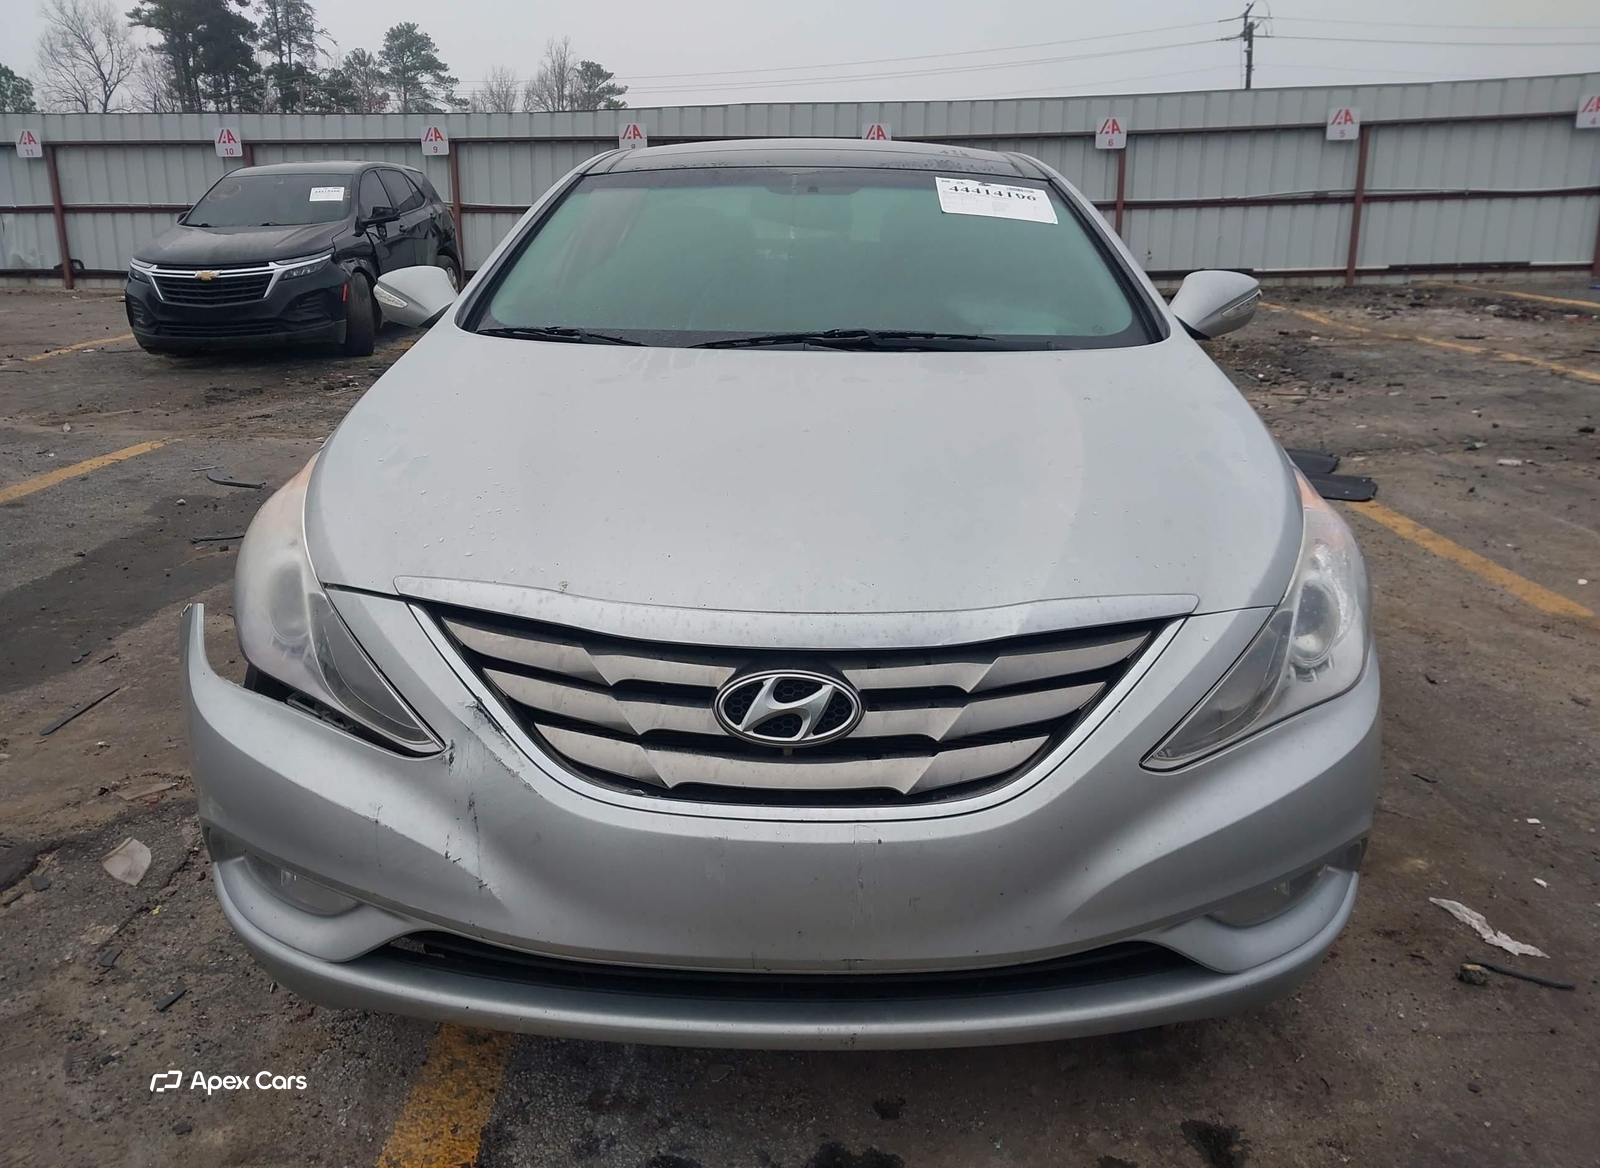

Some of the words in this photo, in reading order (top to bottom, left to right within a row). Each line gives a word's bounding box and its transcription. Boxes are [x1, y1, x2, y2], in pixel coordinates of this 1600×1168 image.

[1339, 129, 1346, 138] 5
[1107, 138, 1114, 147] 6
[25, 148, 35, 156] 11
[225, 147, 235, 156] 10
[432, 145, 438, 154] 9
